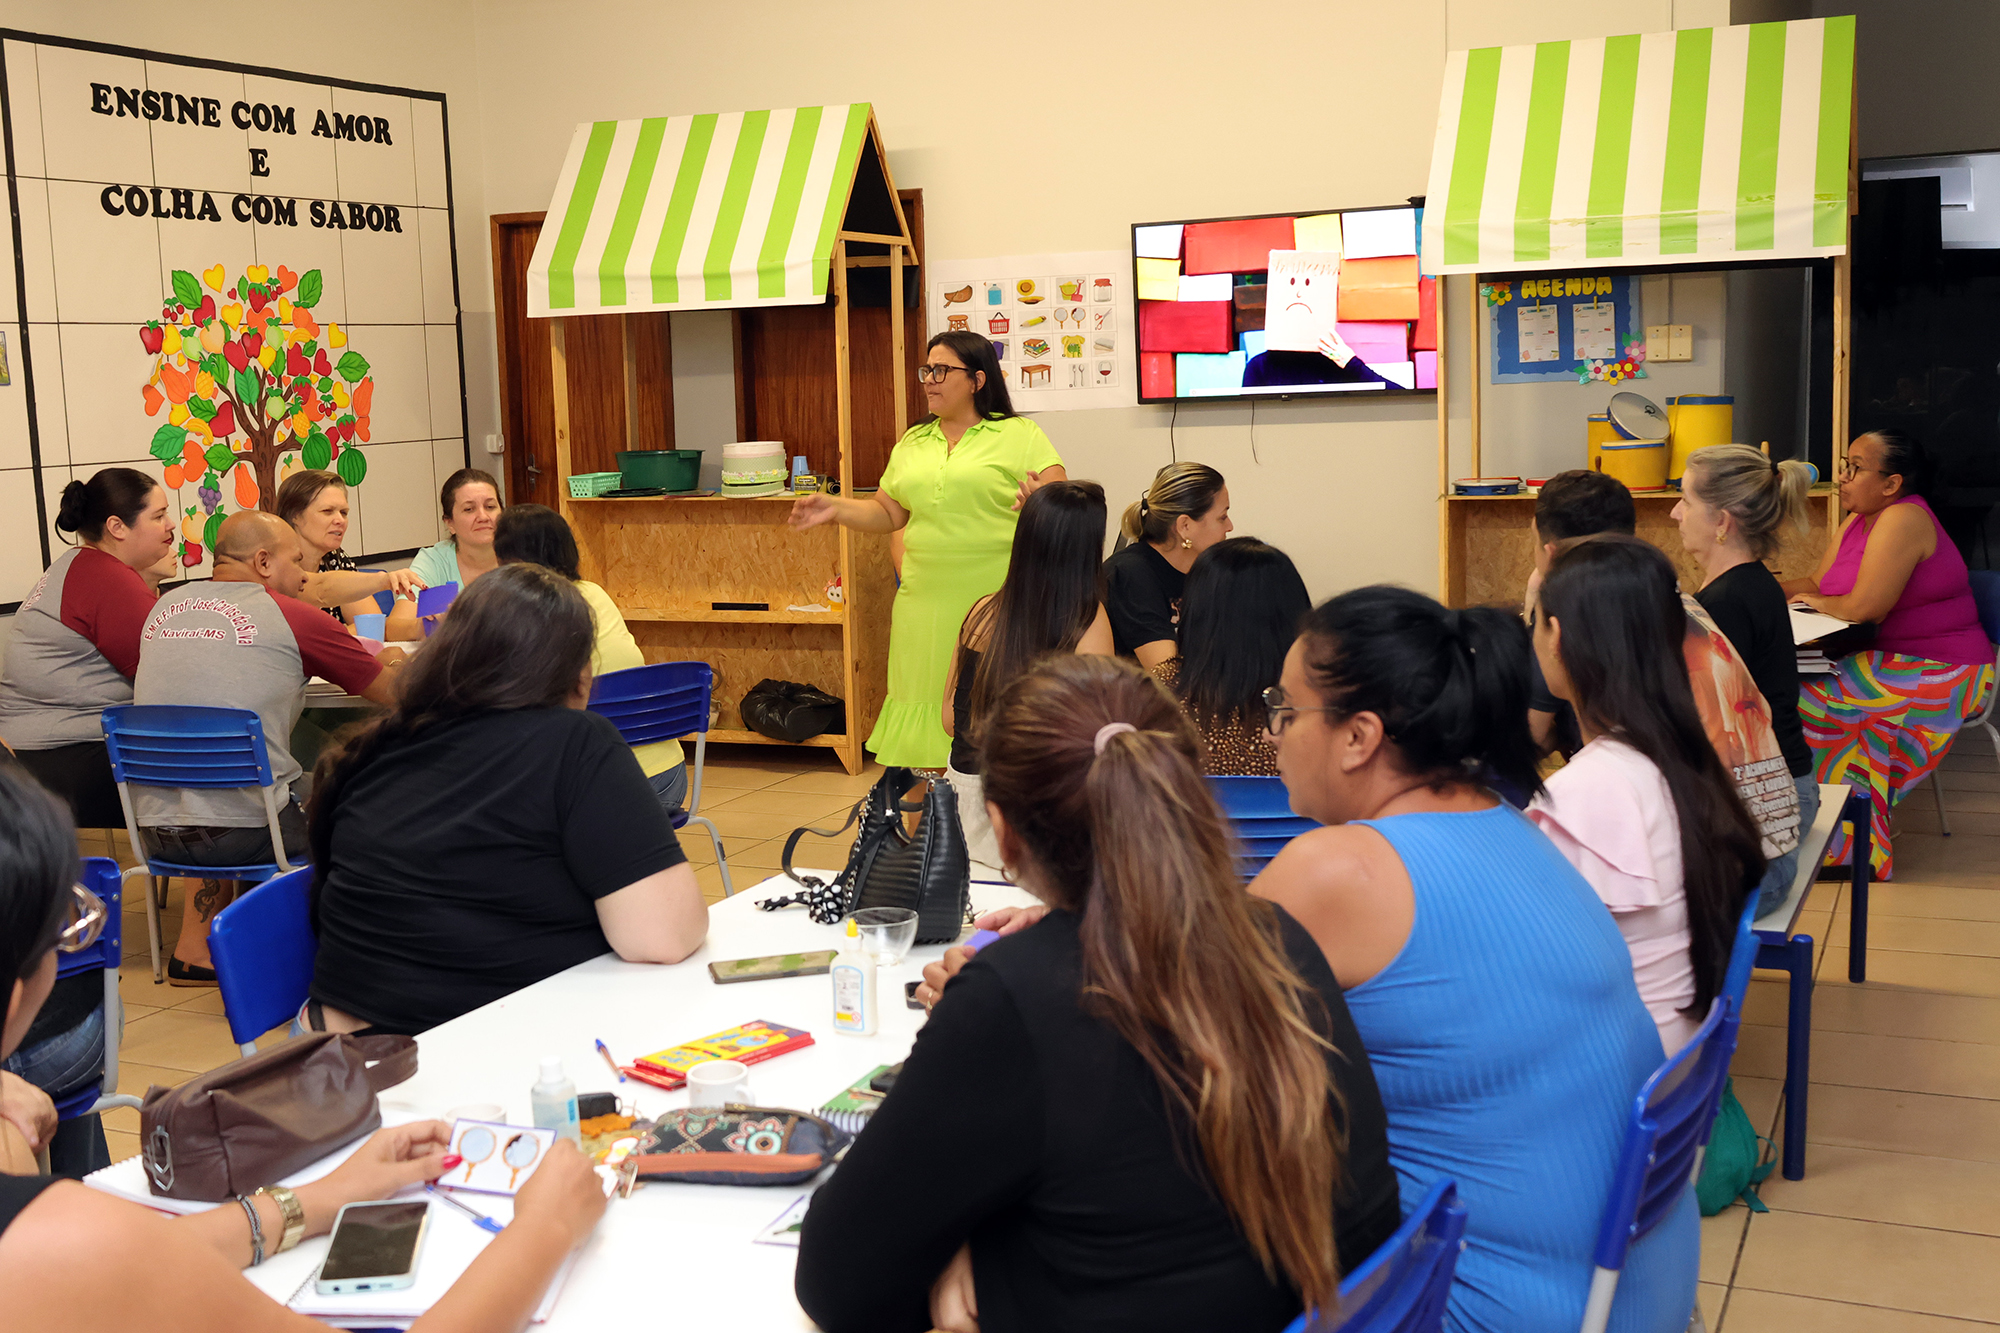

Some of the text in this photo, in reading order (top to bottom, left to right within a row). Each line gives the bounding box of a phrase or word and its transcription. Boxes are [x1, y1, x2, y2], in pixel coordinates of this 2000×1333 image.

[90, 82, 393, 146] ENSINE COM AMOR
[249, 148, 270, 177] E
[100, 184, 403, 233] COLHA COM SABOR
[1521, 277, 1612, 298] AGENDA
[212, 599, 241, 618] Carlos
[230, 614, 251, 627] da
[235, 624, 258, 645] Silva
